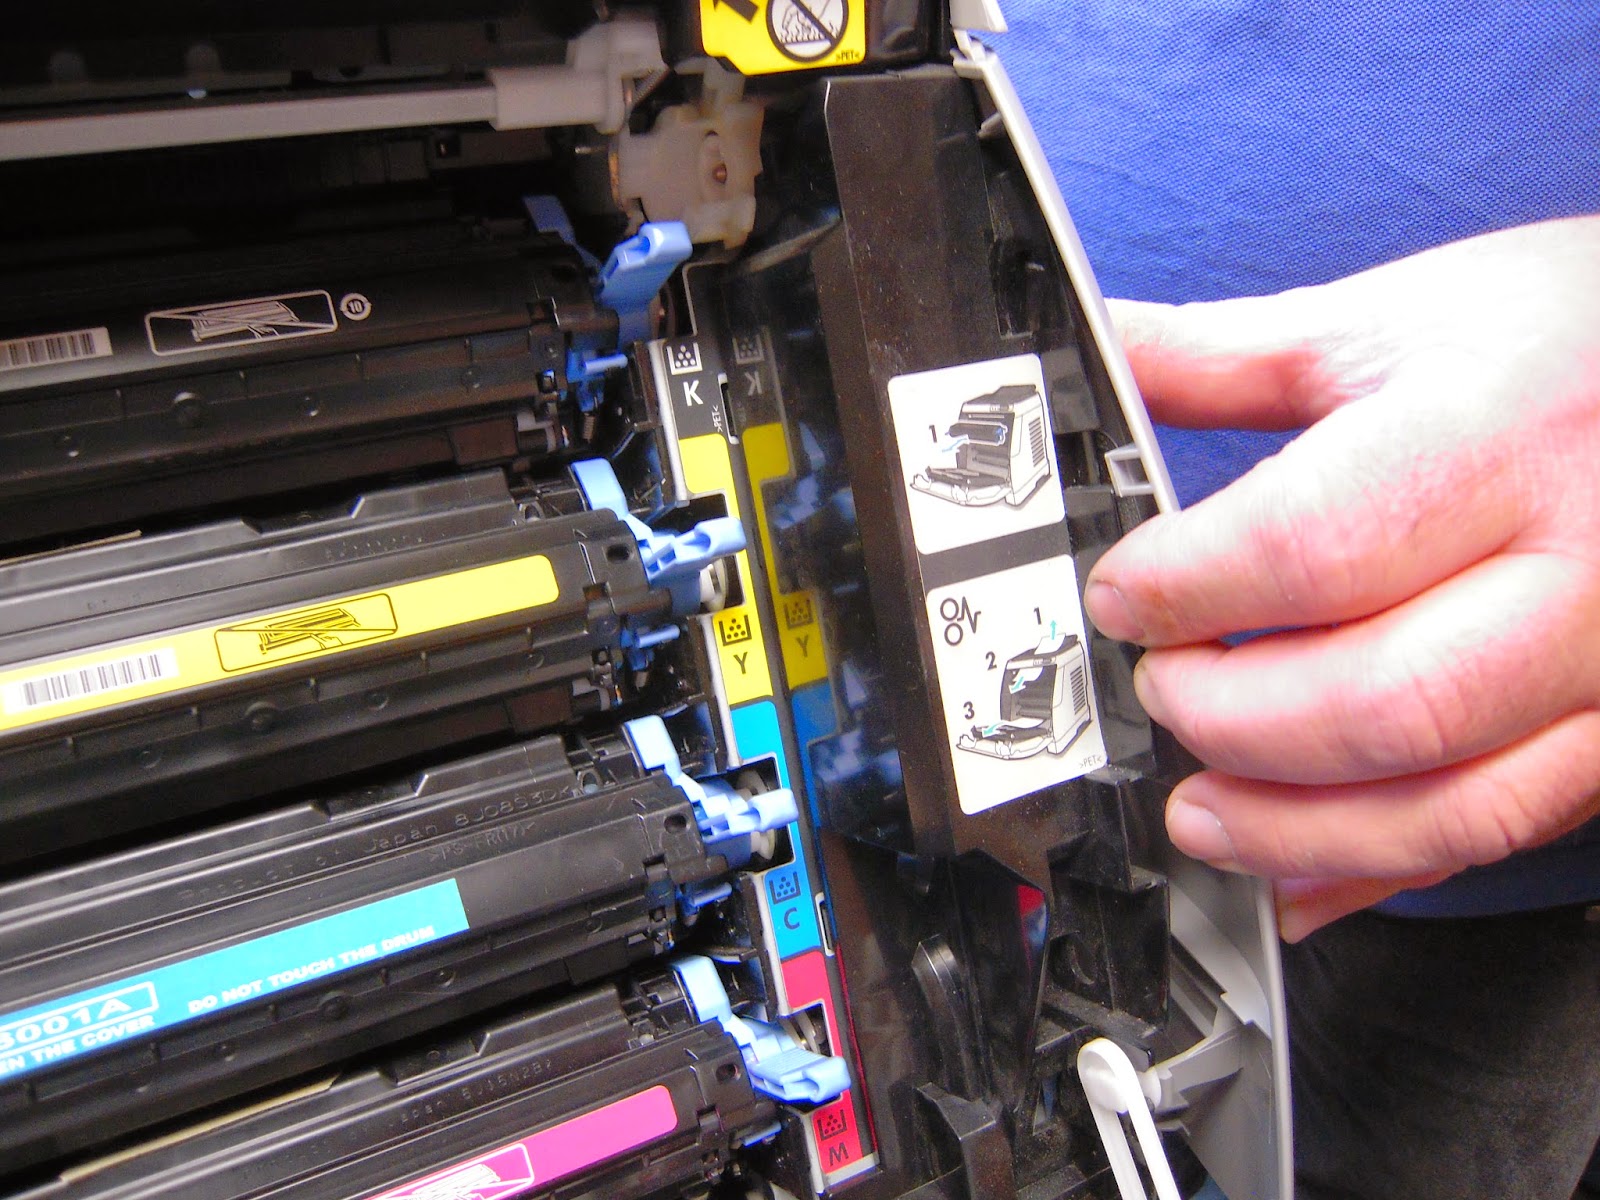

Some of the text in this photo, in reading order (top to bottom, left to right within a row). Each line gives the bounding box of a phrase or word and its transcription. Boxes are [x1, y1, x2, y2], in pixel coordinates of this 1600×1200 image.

[348, 300, 363, 313] 10
[682, 379, 704, 407] K
[928, 424, 938, 443] 1
[1033, 606, 1042, 625] 1
[733, 651, 748, 675] Y
[985, 651, 998, 671] 2
[963, 700, 976, 720] 3
[783, 906, 801, 931] C
[187, 925, 436, 1014] DO NOT TOUCH THE DRUM
[31, 1038, 76, 1063] THE
[80, 1014, 156, 1047] COVER
[829, 1142, 849, 1166] M
